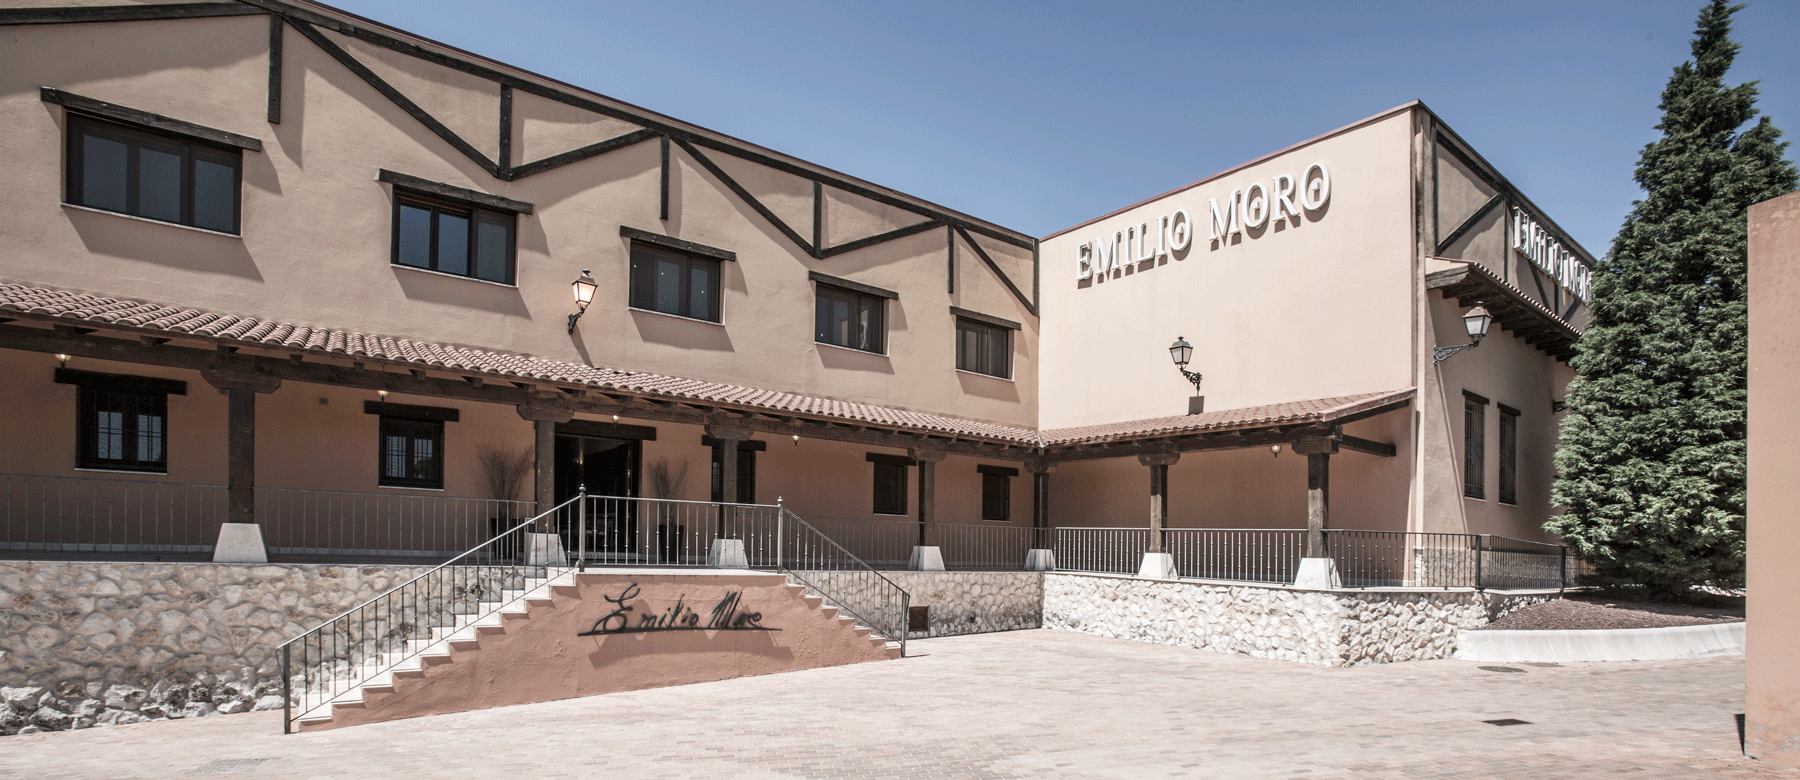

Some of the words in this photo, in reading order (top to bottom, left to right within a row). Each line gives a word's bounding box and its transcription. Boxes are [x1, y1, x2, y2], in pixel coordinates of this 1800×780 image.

[1075, 209, 1192, 282] EMILIO
[1208, 162, 1332, 245] MORO
[1562, 250, 1593, 302] MOR
[590, 583, 700, 634] Emilio
